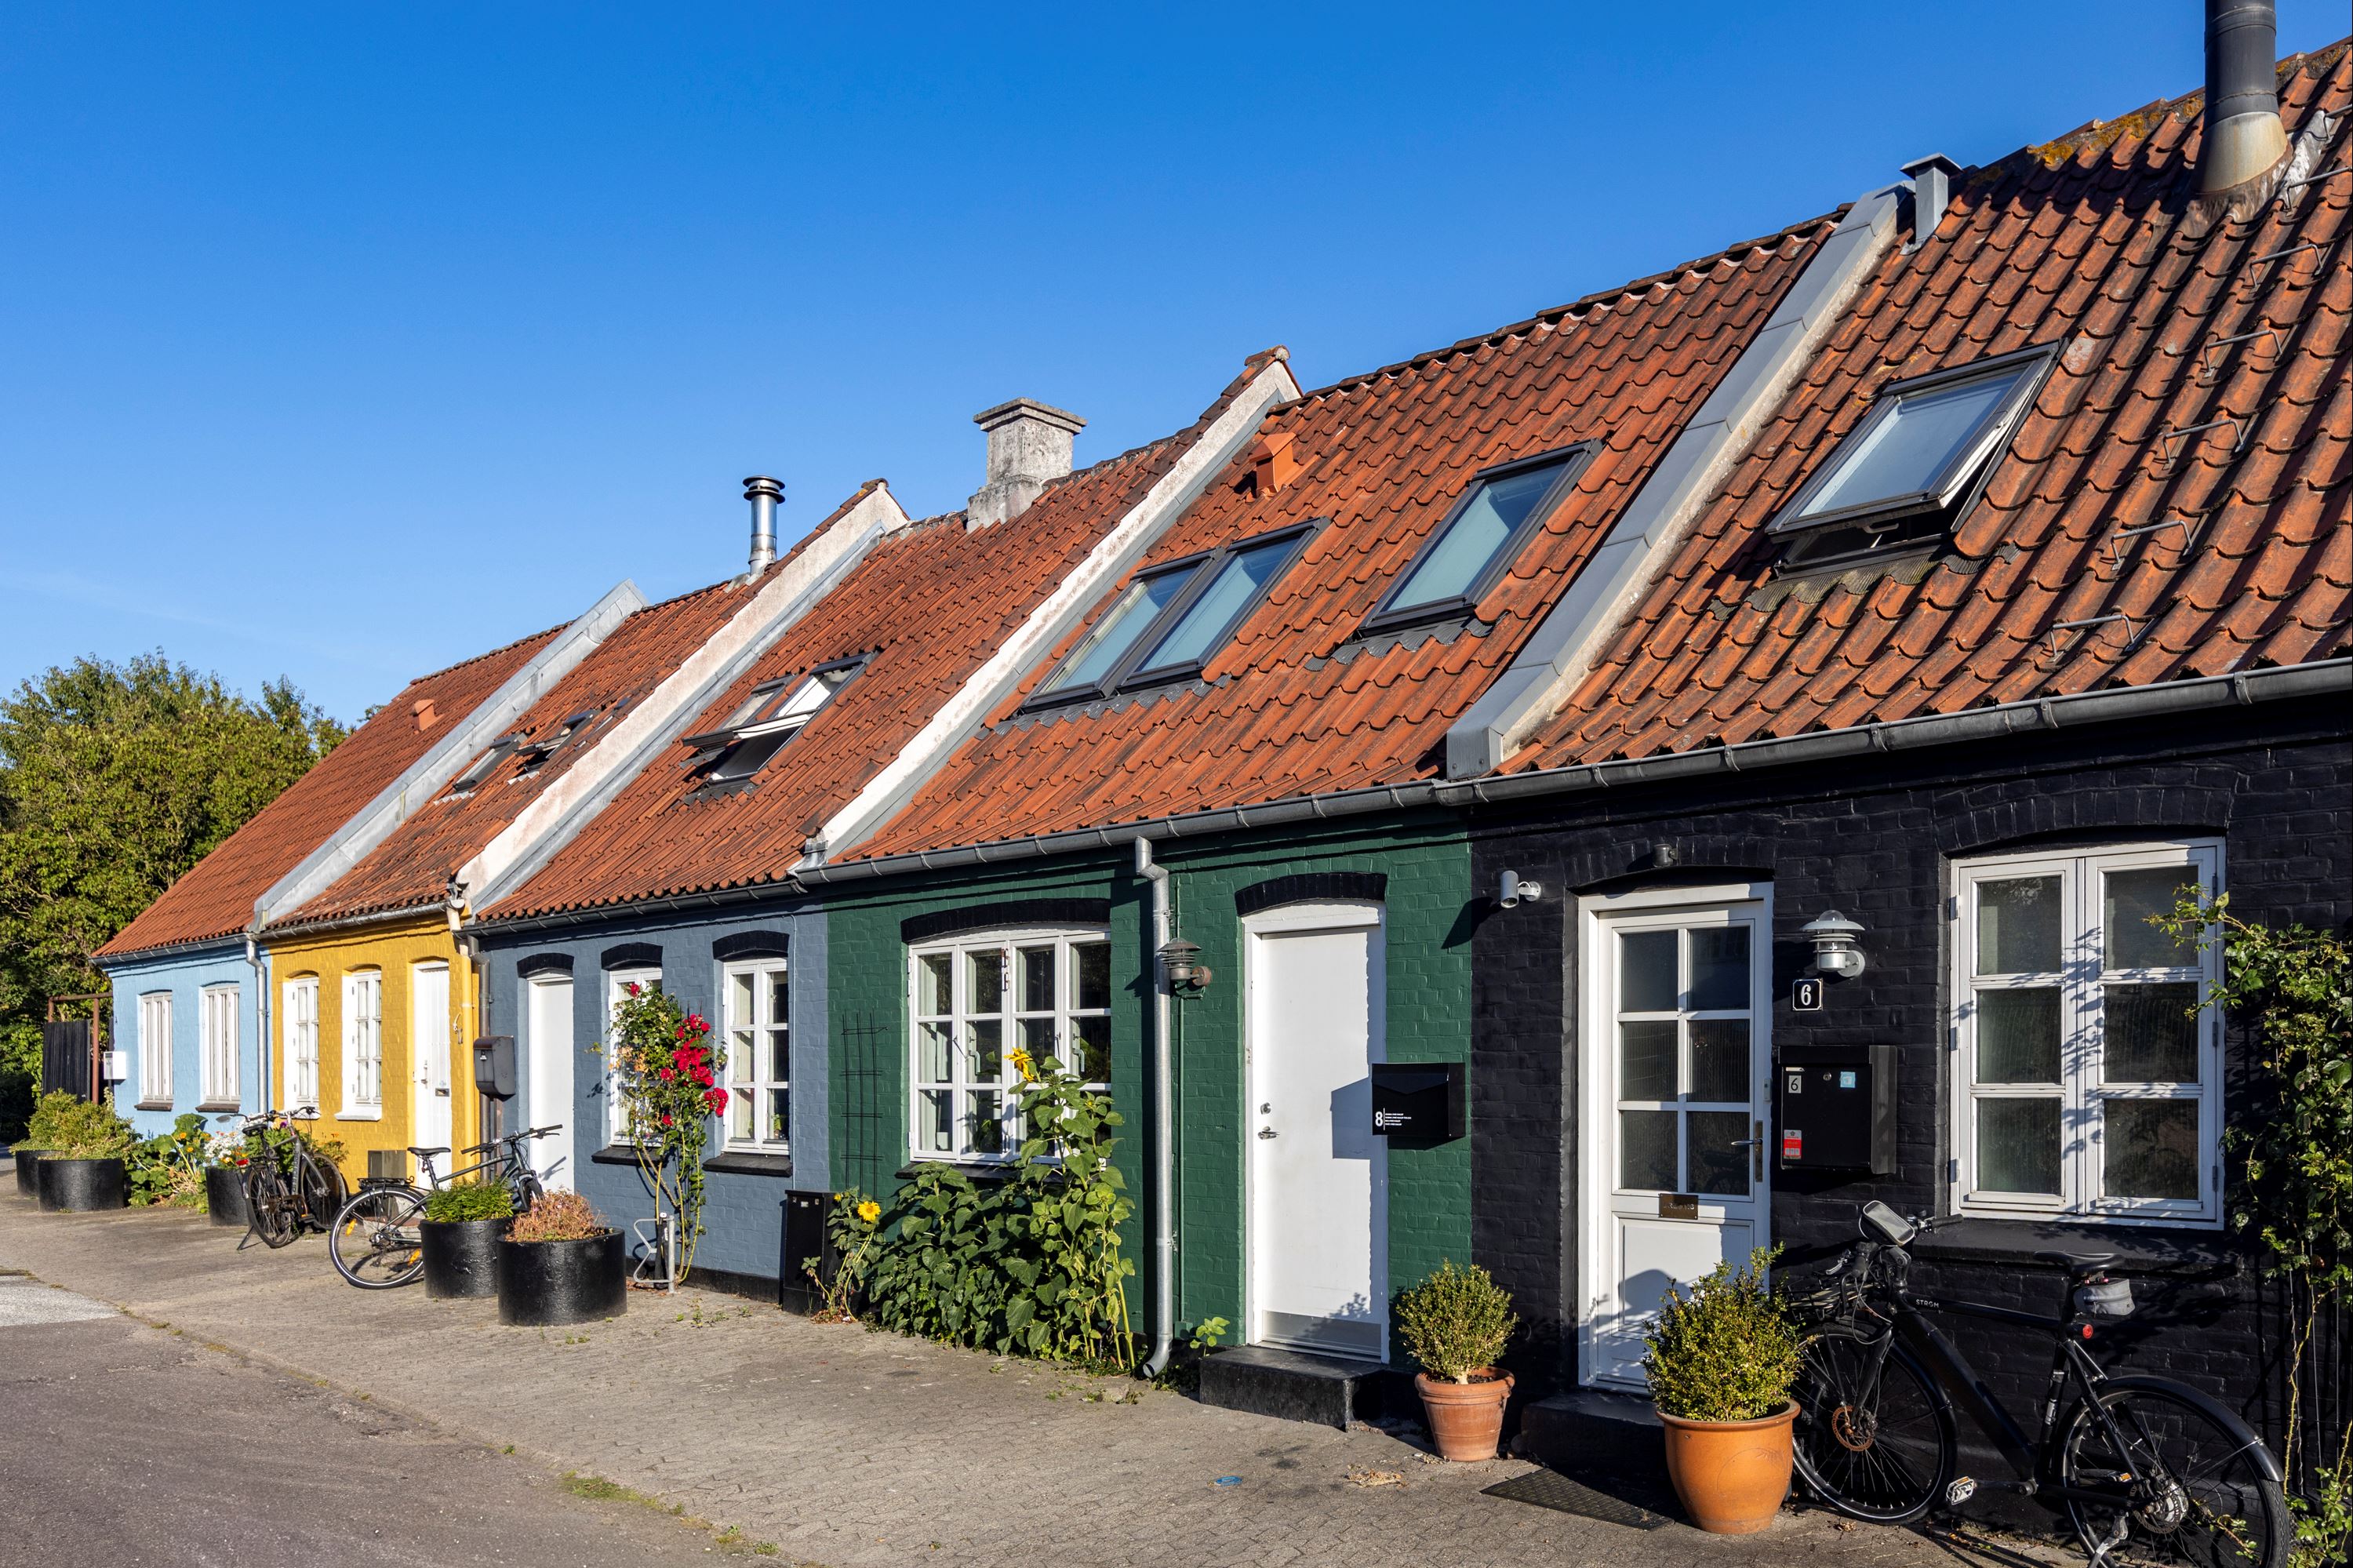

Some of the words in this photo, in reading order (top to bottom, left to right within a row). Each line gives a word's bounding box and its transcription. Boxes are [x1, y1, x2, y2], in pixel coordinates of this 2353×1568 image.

[1801, 984, 1812, 1006] 6
[1791, 1078, 1798, 1091] 6
[1375, 1111, 1384, 1127] 8
